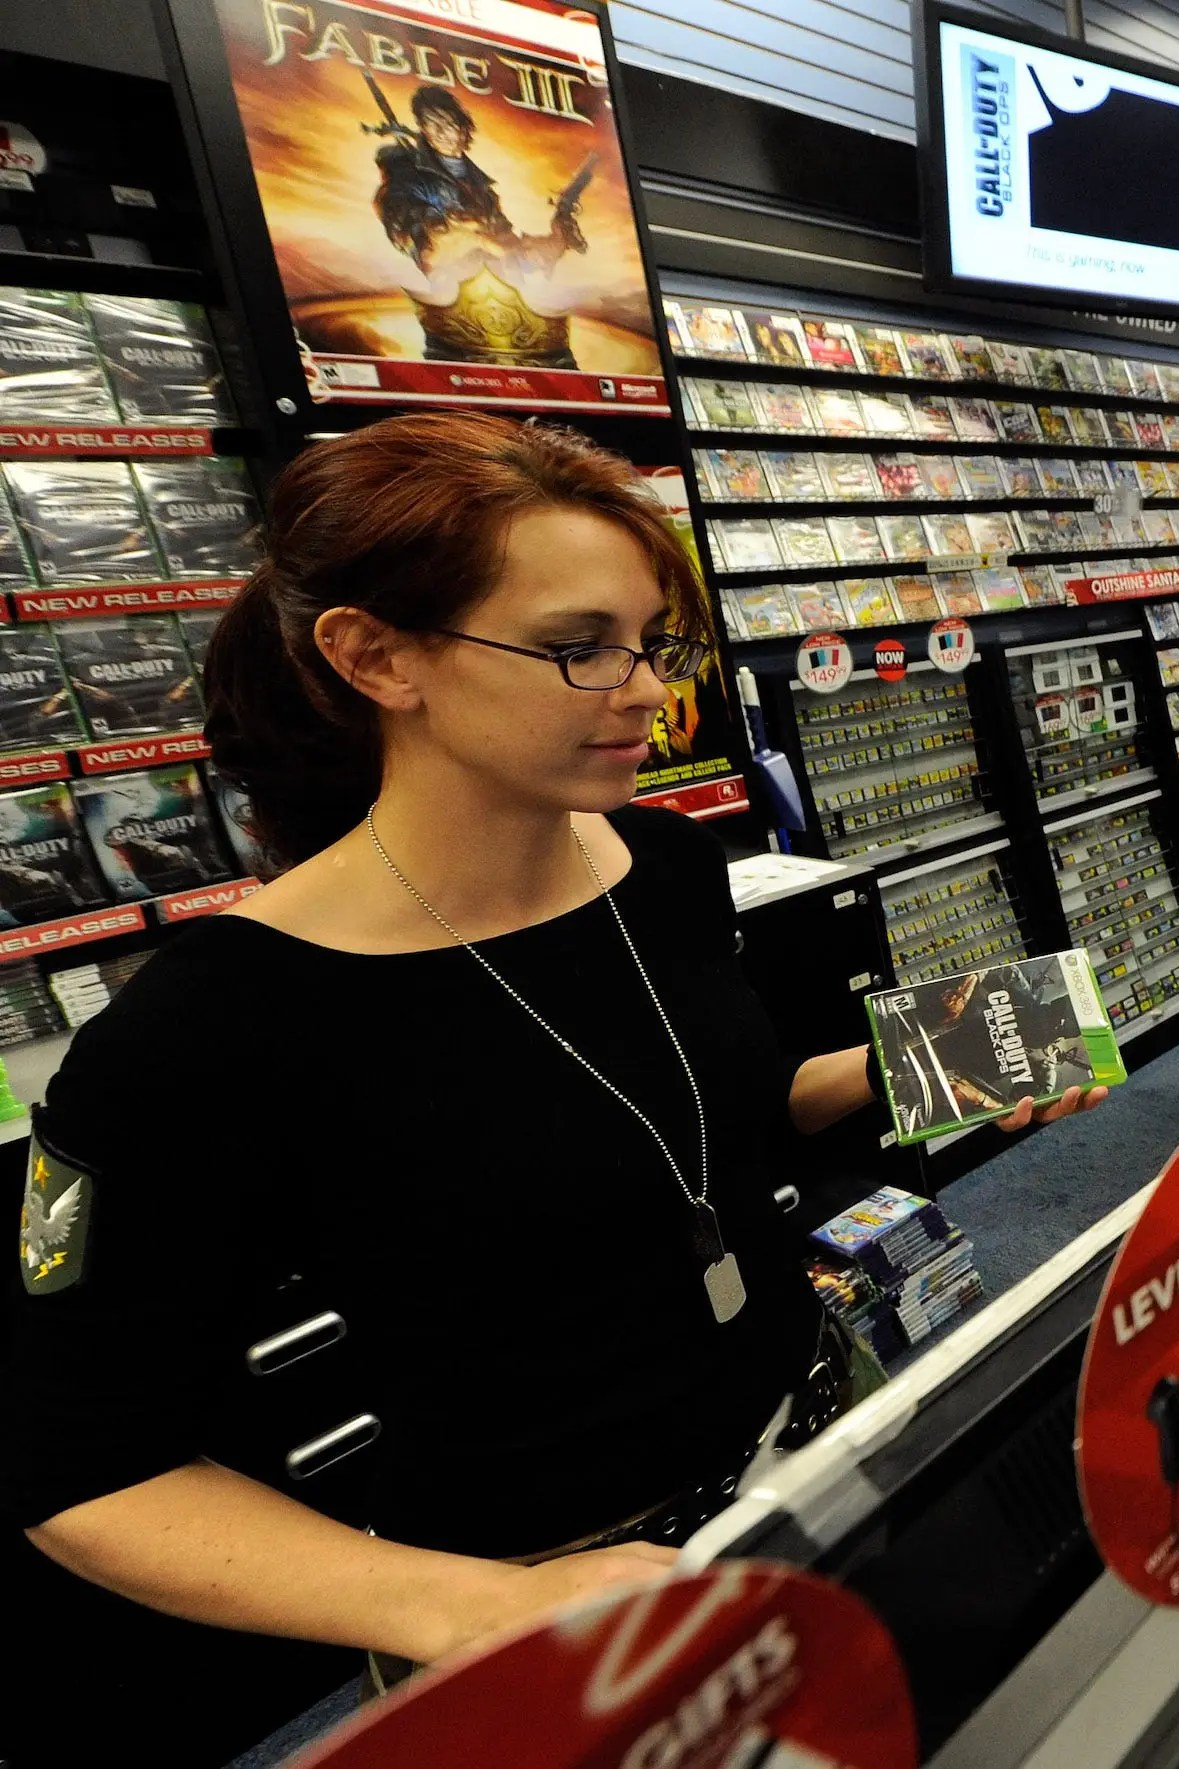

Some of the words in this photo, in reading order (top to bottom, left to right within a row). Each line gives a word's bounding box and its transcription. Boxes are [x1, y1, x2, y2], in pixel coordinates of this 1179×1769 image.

[264, 2, 493, 96] FABLE
[494, 52, 597, 129] III
[972, 58, 1000, 138] DUTY
[1000, 81, 1010, 126] OPS
[976, 149, 1004, 217] CALL
[1001, 135, 1013, 202] BLACK
[57, 431, 206, 449] RELEASES
[23, 596, 98, 613] NEW
[103, 586, 242, 607] RELEASES
[1091, 574, 1146, 595] OUTSHINE
[875, 651, 905, 664] NOW
[86, 747, 156, 766] NEW
[170, 889, 236, 914] NEW
[894, 996, 910, 1010] M
[987, 989, 1018, 1036] CALL
[983, 1008, 1003, 1049] BLACK
[994, 1048, 1010, 1074] OPS
[1001, 1034, 1034, 1084] DUTY
